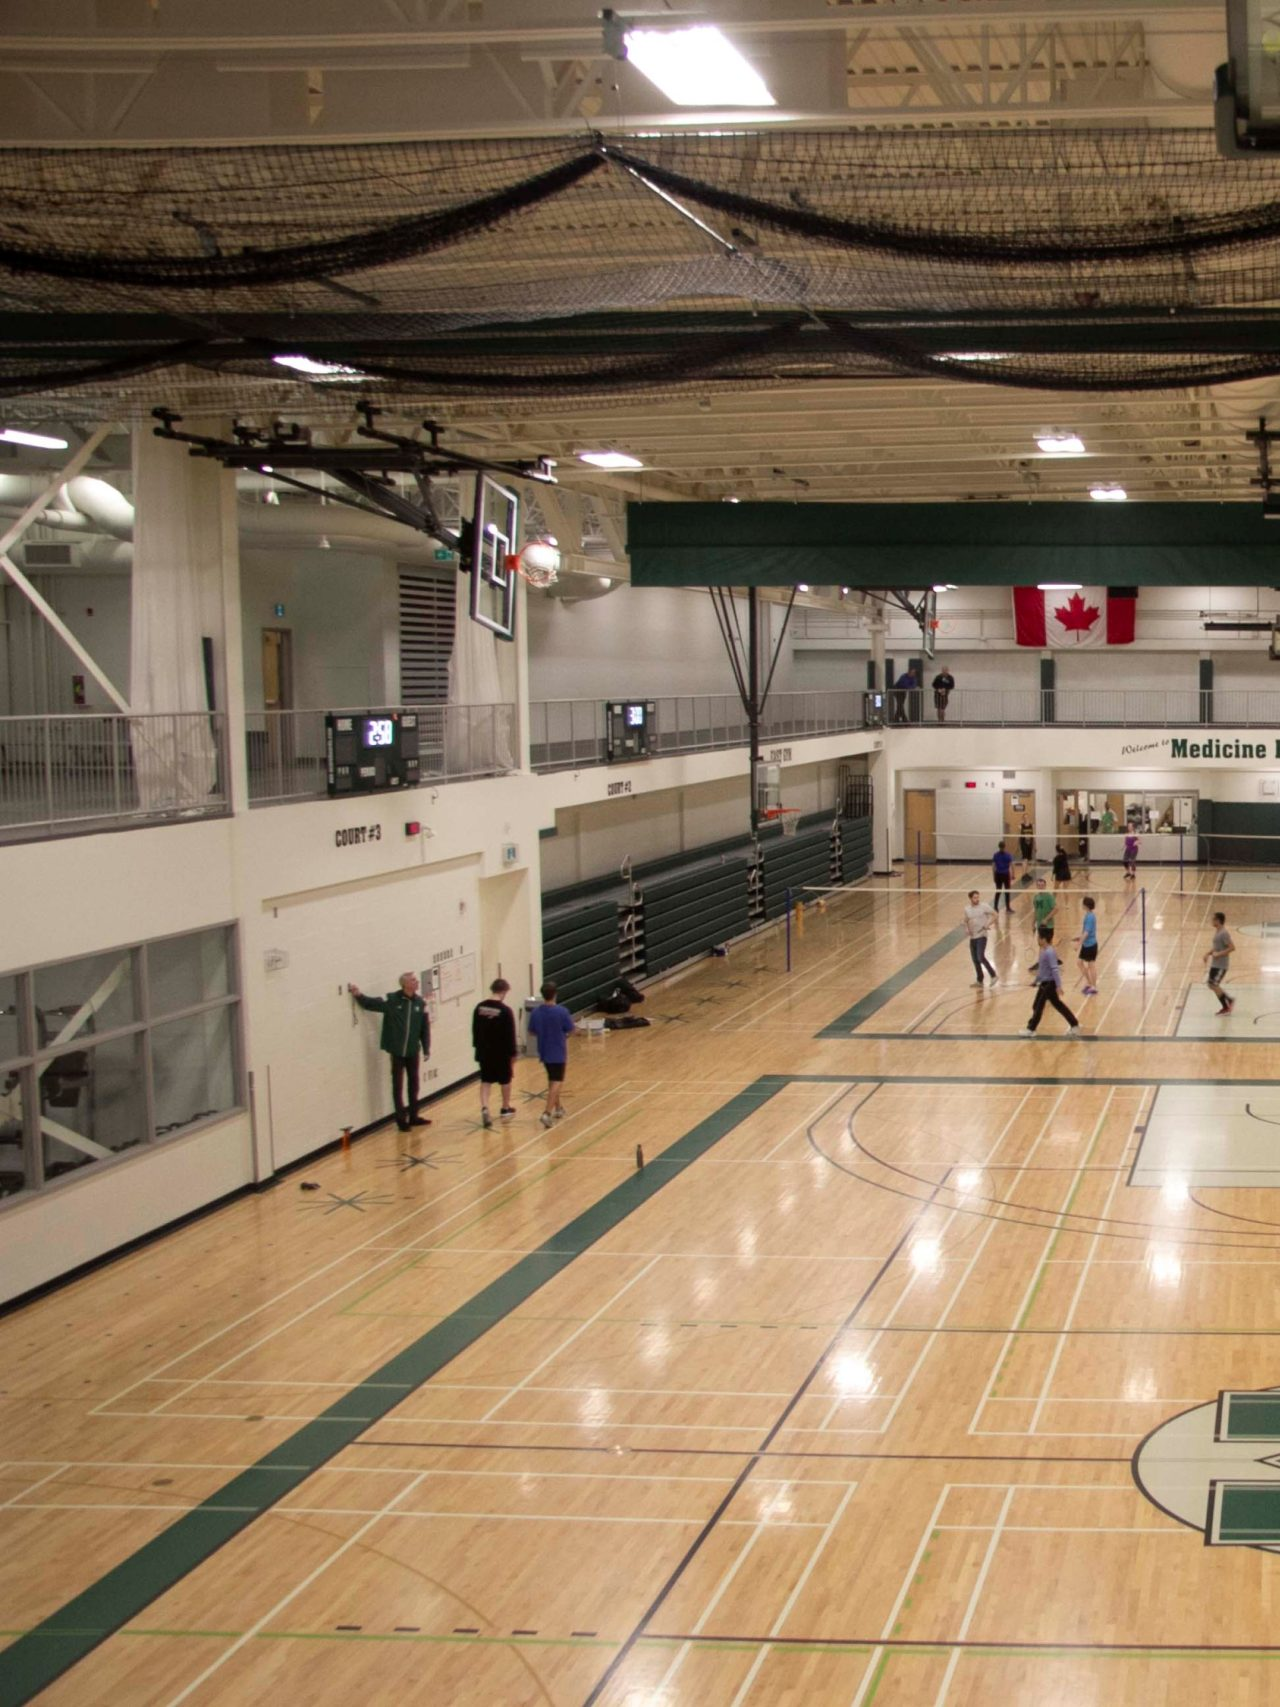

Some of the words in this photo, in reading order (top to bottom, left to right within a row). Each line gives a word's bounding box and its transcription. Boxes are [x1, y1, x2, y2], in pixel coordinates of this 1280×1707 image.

[1121, 742, 1159, 756] Welcome
[1161, 738, 1170, 747] to
[1171, 738, 1267, 759] Medicine
[335, 826, 367, 848] COURT
[368, 823, 382, 842] #3
